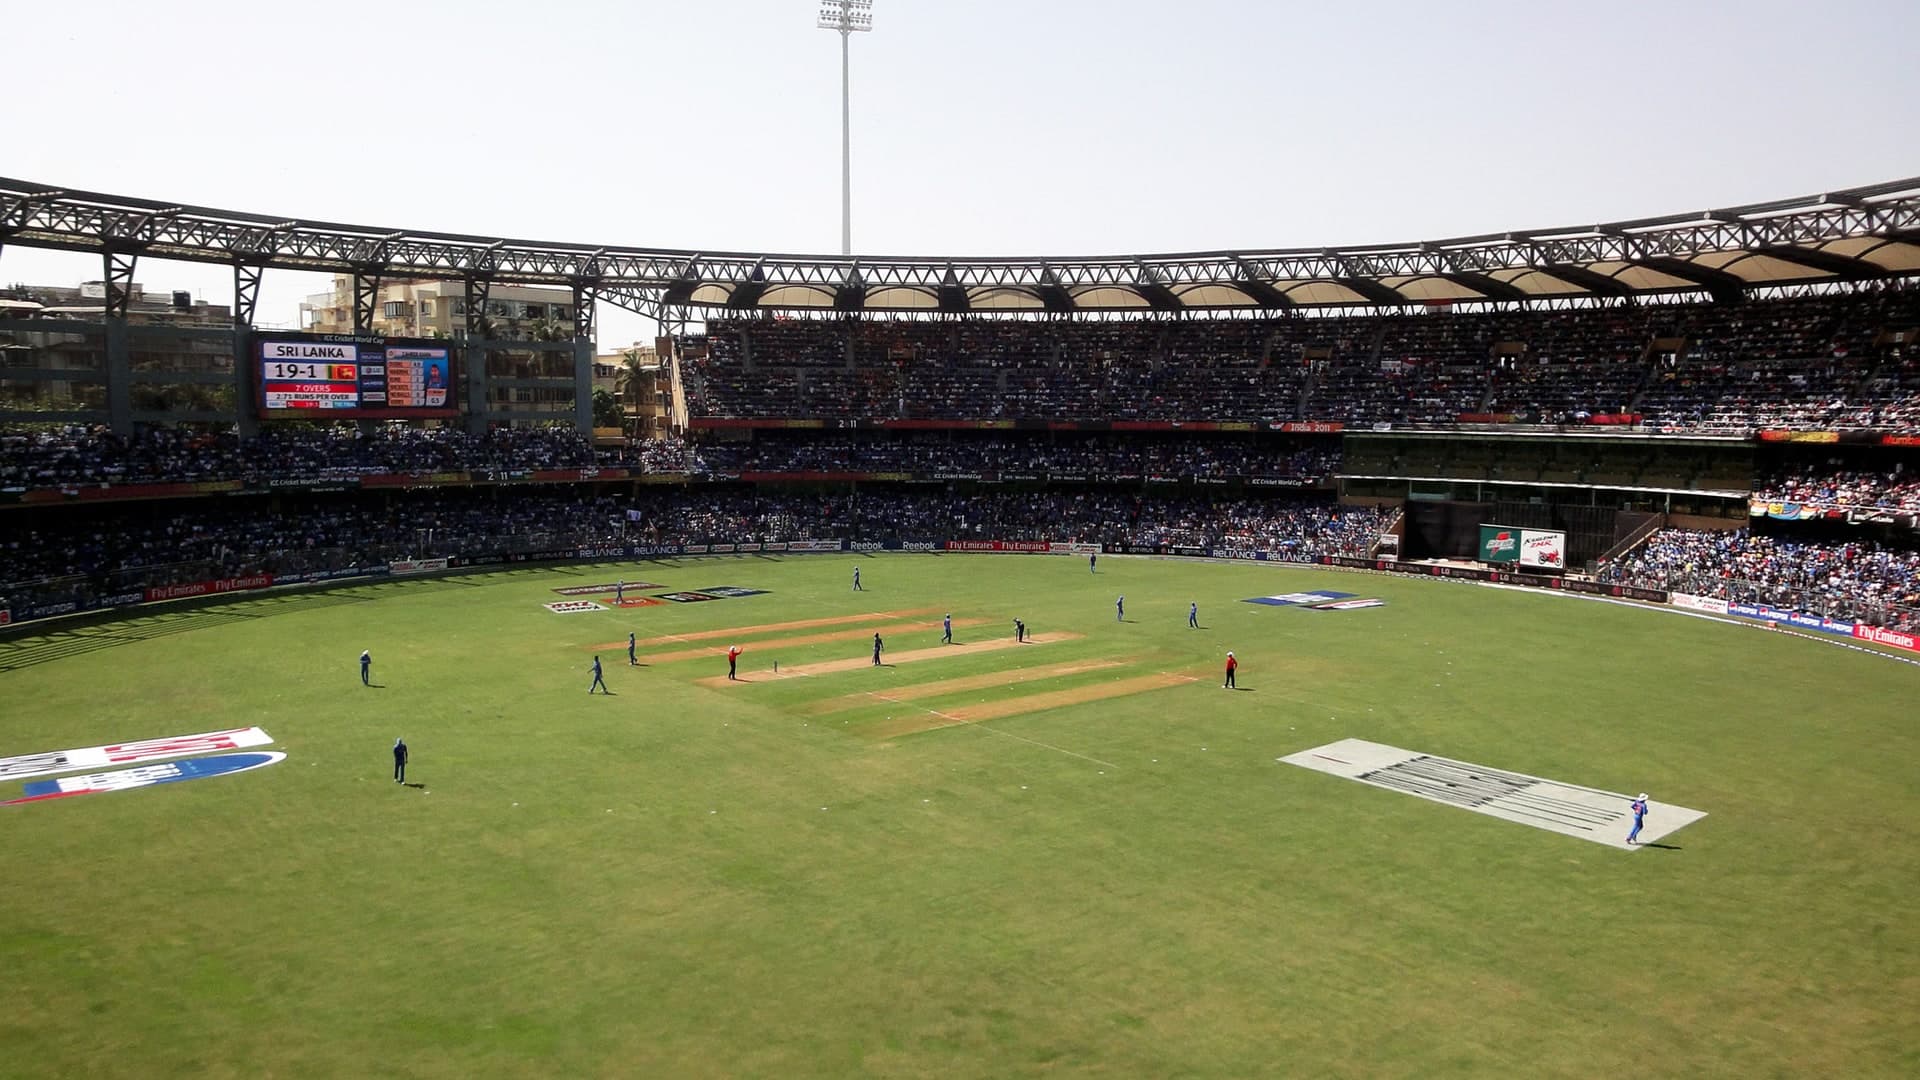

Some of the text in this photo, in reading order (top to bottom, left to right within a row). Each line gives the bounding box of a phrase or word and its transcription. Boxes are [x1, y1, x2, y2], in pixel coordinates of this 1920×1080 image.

[373, 337, 384, 345] Cup
[277, 346, 345, 358] SRI LANKA
[275, 363, 317, 378] 19-1
[1292, 423, 1330, 432] India 2011
[1278, 479, 1293, 487] World
[1293, 480, 1303, 488] Cup
[634, 545, 678, 555] RELIANCE
[851, 541, 884, 550] Reebok
[903, 541, 936, 550] Reebok
[950, 541, 994, 551] Fly Emirates
[1002, 541, 1013, 551] Fly
[1014, 542, 1046, 550] Emirates
[579, 547, 624, 558] RELIANCE
[1213, 549, 1257, 560] RELIANCE
[1266, 551, 1312, 563] RELIANCE
[215, 576, 267, 591] Fly Emirates
[151, 583, 206, 600] Fly Emirates
[1859, 625, 1915, 647] Fly Emirates
